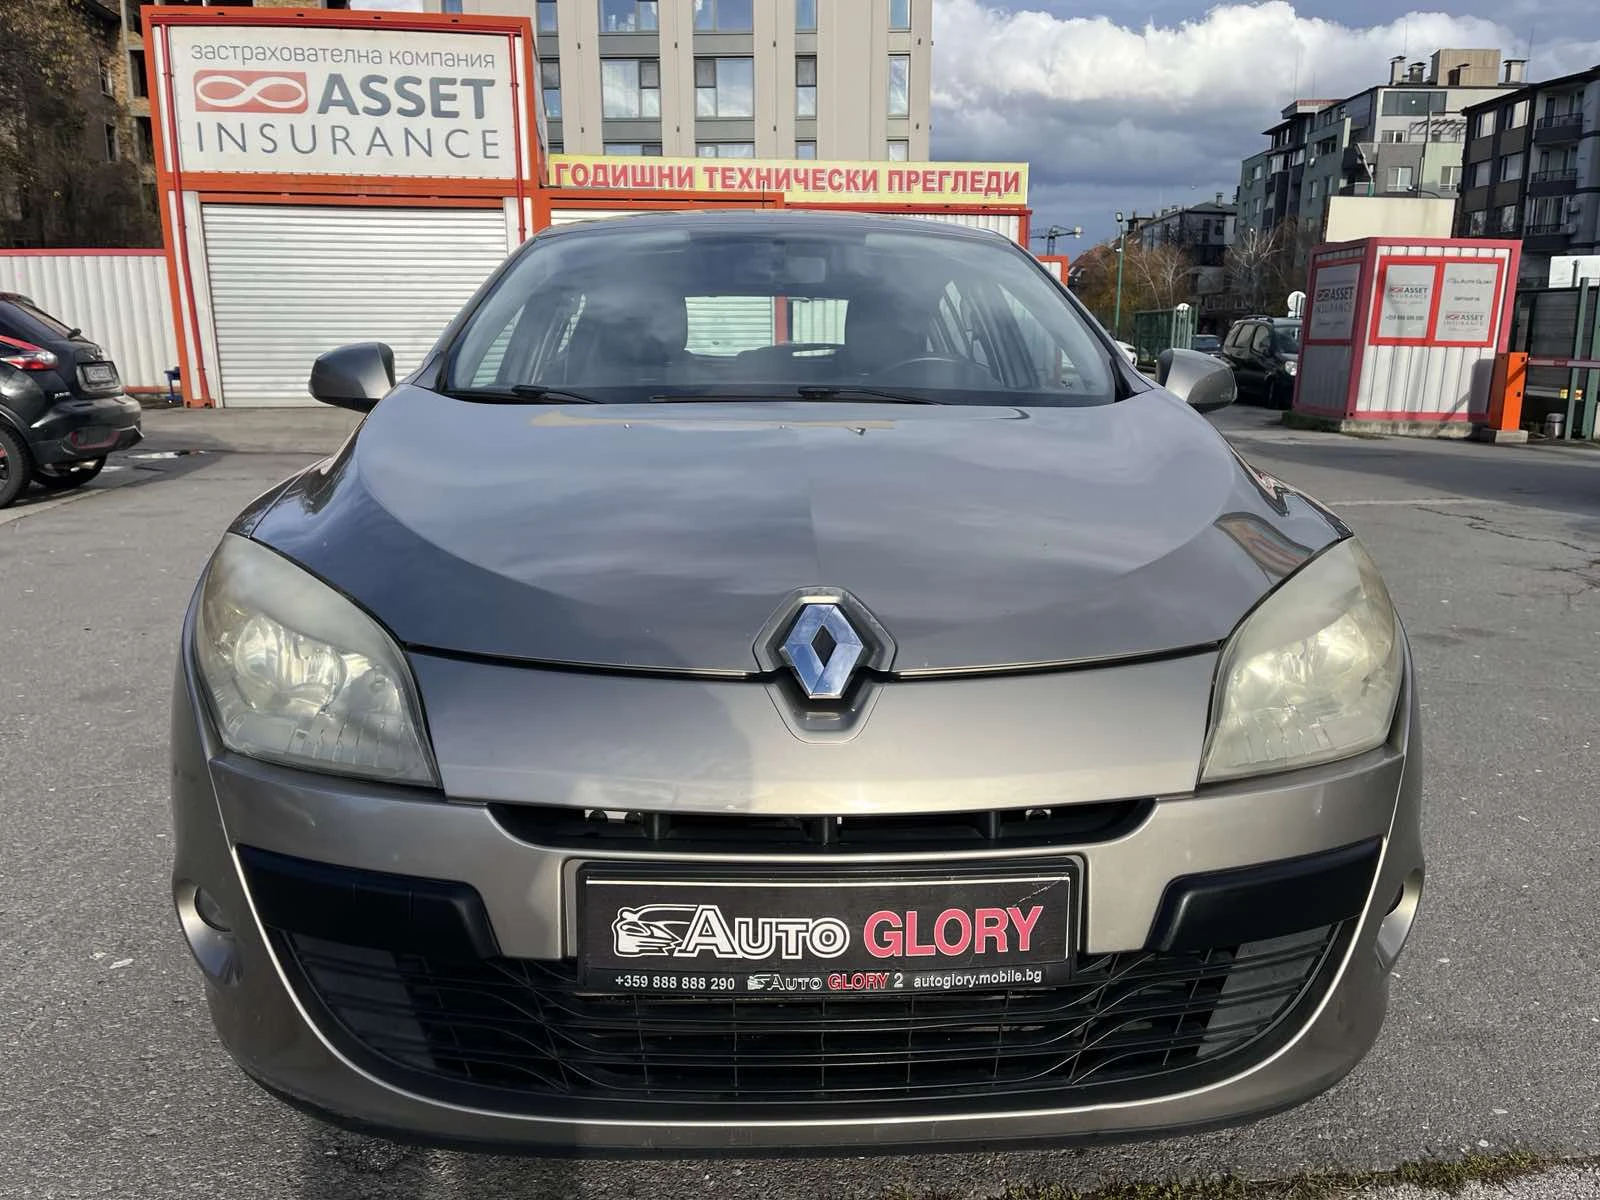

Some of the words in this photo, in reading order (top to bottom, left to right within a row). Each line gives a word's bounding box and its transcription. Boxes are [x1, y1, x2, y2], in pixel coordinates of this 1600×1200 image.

[191, 43, 383, 66] застрахователна
[389, 50, 496, 69] компания
[316, 72, 497, 120] ASSET
[195, 120, 500, 160] INSURANCE
[554, 162, 695, 189] ГОДИШНИ
[702, 166, 879, 194] ТЕХНИЧЕСКИ
[886, 169, 1020, 199] ПРЕГЛЕДИ
[863, 905, 1044, 959] GLORY
[615, 974, 649, 988] +359
[652, 975, 678, 989] 888
[681, 976, 707, 990] 888
[710, 977, 736, 991] 290
[827, 972, 890, 990] GLORY
[893, 973, 904, 988] 2
[913, 969, 1042, 989] autoglory.mobile.bg
